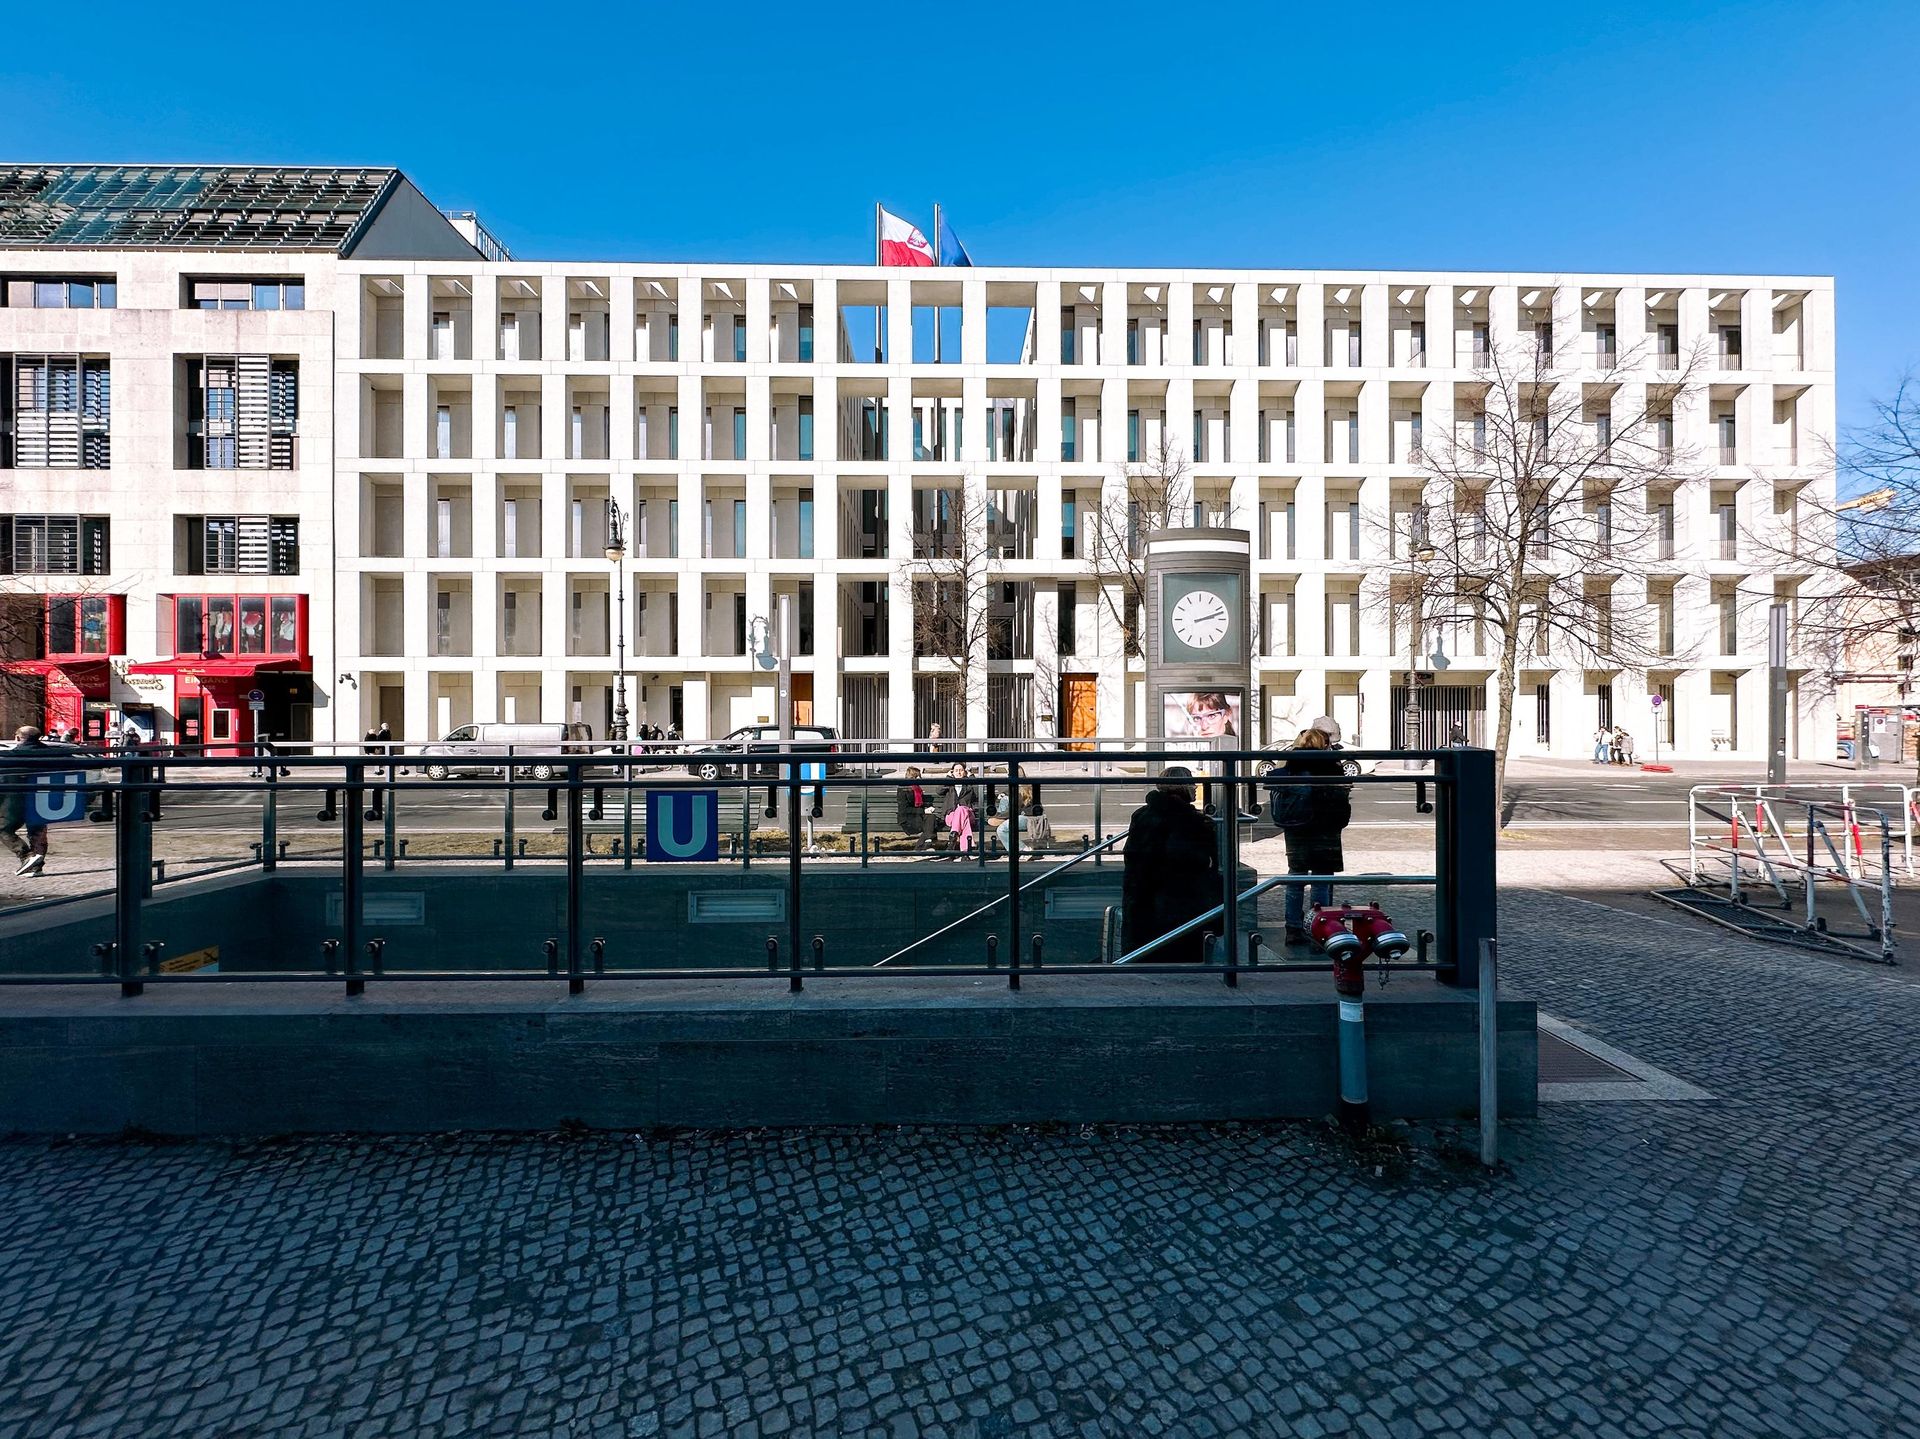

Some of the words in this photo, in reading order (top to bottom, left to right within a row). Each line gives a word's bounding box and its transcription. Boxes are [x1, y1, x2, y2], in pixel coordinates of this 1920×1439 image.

[184, 676, 228, 684] EINGANG
[35, 775, 78, 820] U
[657, 794, 708, 858] U
